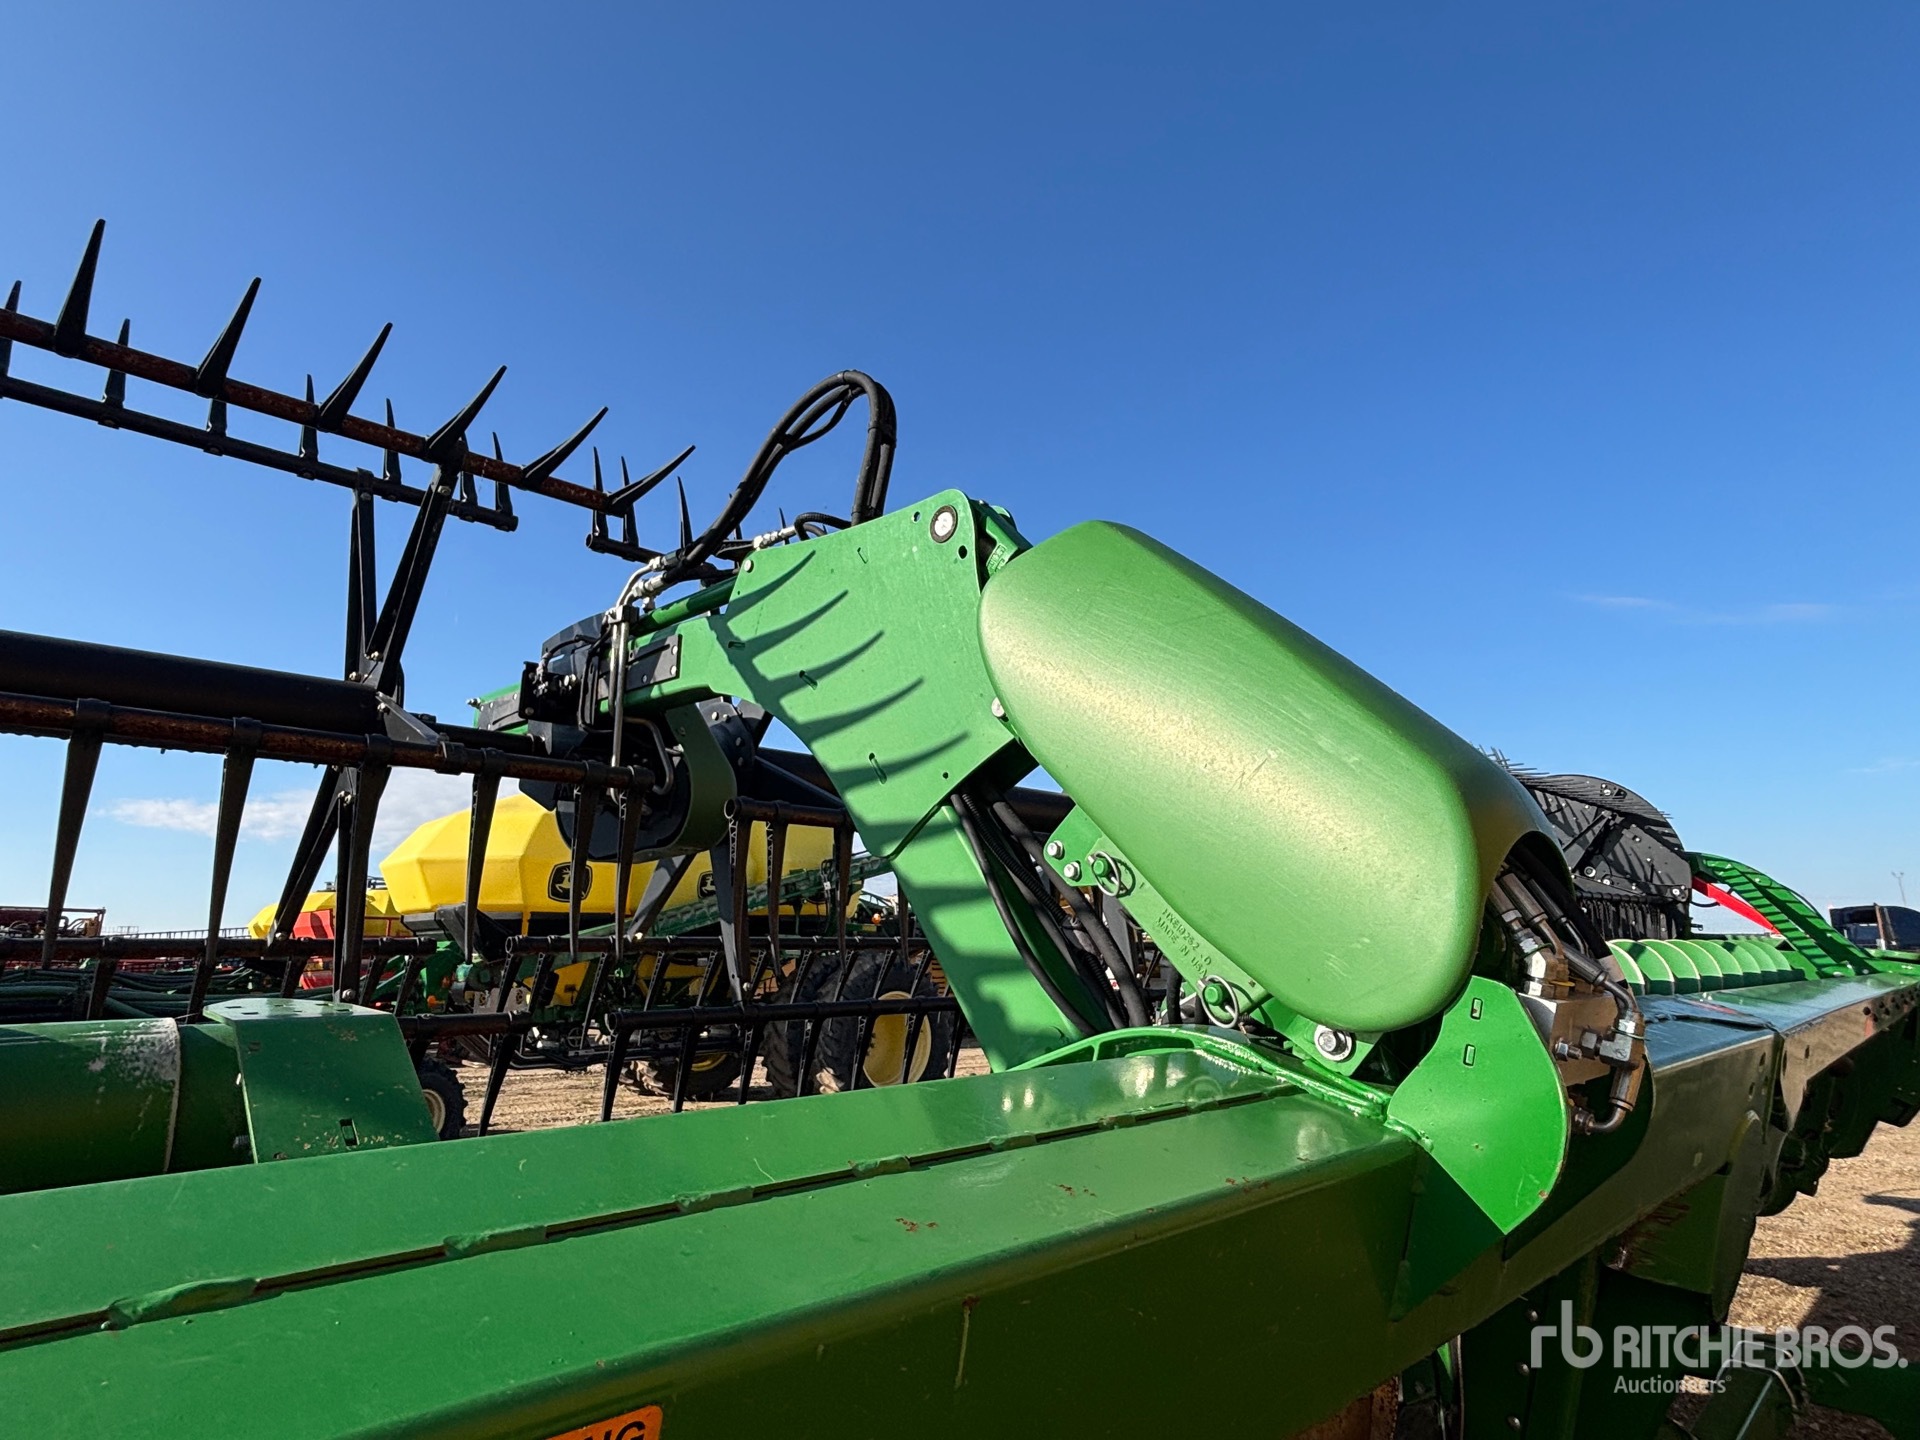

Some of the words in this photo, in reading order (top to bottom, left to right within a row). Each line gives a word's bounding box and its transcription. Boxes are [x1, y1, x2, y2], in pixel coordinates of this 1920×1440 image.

[1156, 916, 1179, 944] MADE
[1179, 943, 1190, 957] IN
[1191, 956, 1208, 977] USA
